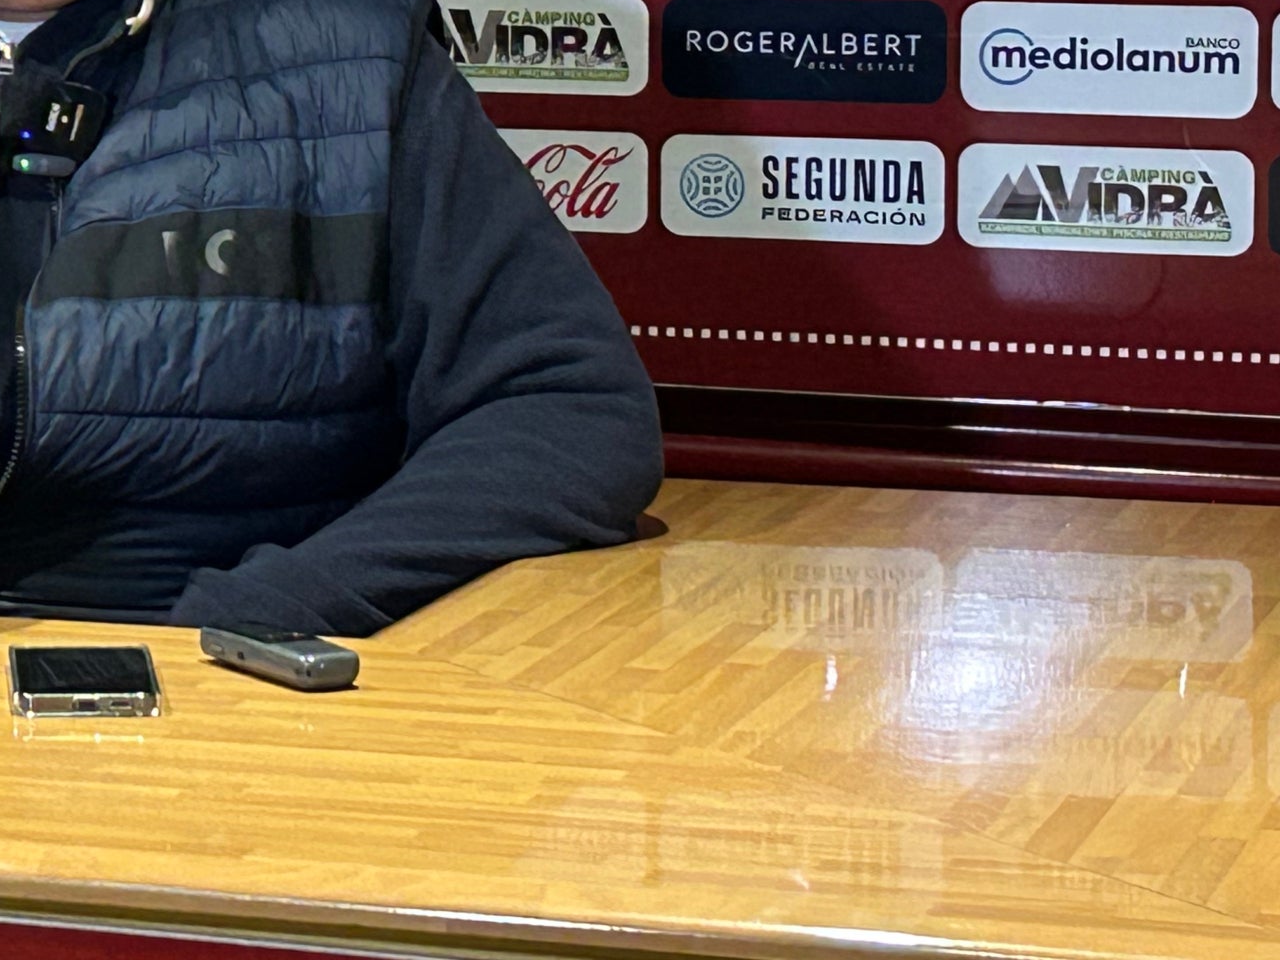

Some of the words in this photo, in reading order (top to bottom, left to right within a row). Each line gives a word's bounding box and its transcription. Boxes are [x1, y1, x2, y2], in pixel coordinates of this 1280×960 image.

[991, 37, 1240, 76] mediolanum
[1186, 37, 1240, 50] BANCO
[762, 156, 925, 204] SEGUNDA
[761, 207, 926, 226] FEDERACIÓN
